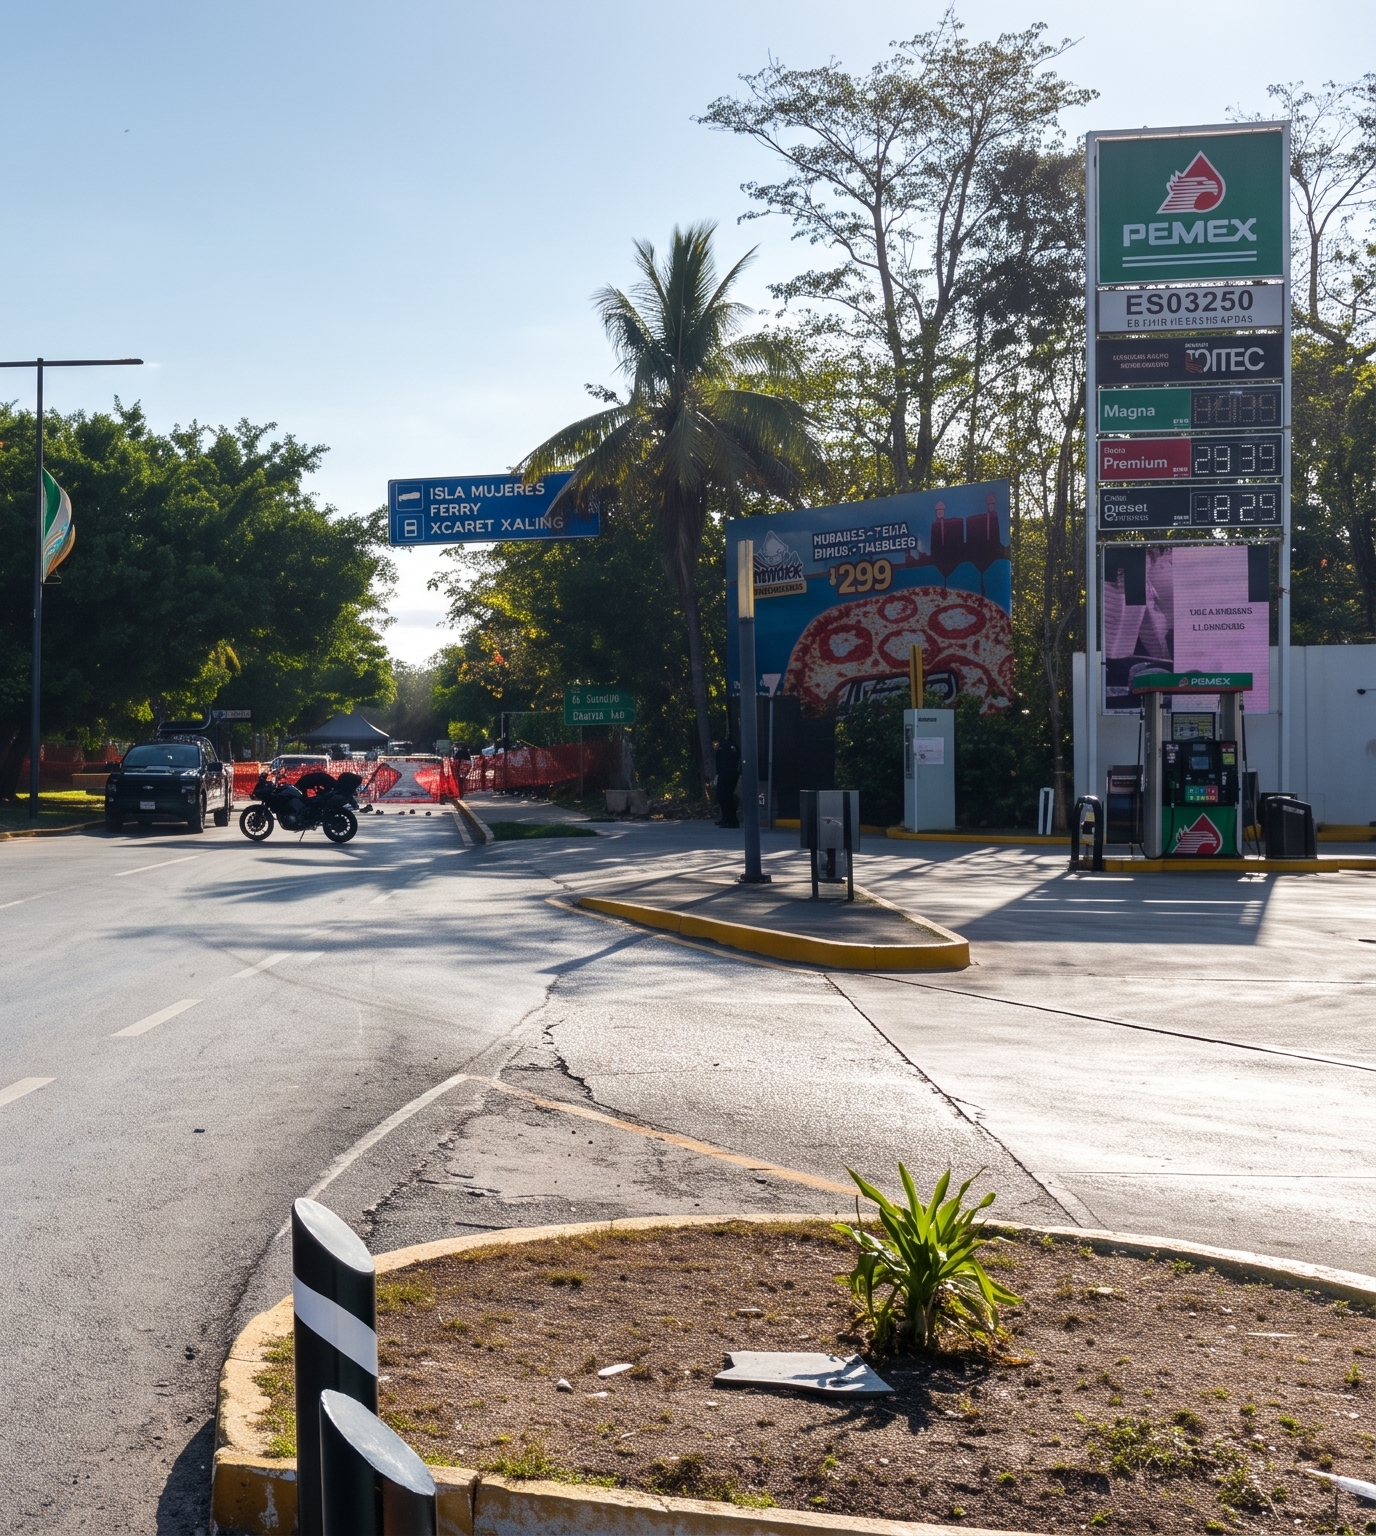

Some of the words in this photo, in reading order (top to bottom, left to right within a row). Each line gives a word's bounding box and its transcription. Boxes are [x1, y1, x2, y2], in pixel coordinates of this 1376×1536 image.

[1123, 217, 1257, 247] PEMEX
[1126, 290, 1253, 315] ES03250
[1104, 404, 1156, 420] Magna
[1104, 456, 1168, 469] Premium
[430, 486, 465, 500] ISLA
[471, 483, 545, 498] MUJERES
[430, 503, 481, 517] FERRY
[430, 520, 495, 535] XCARET
[1191, 677, 1231, 685] PEMEX
